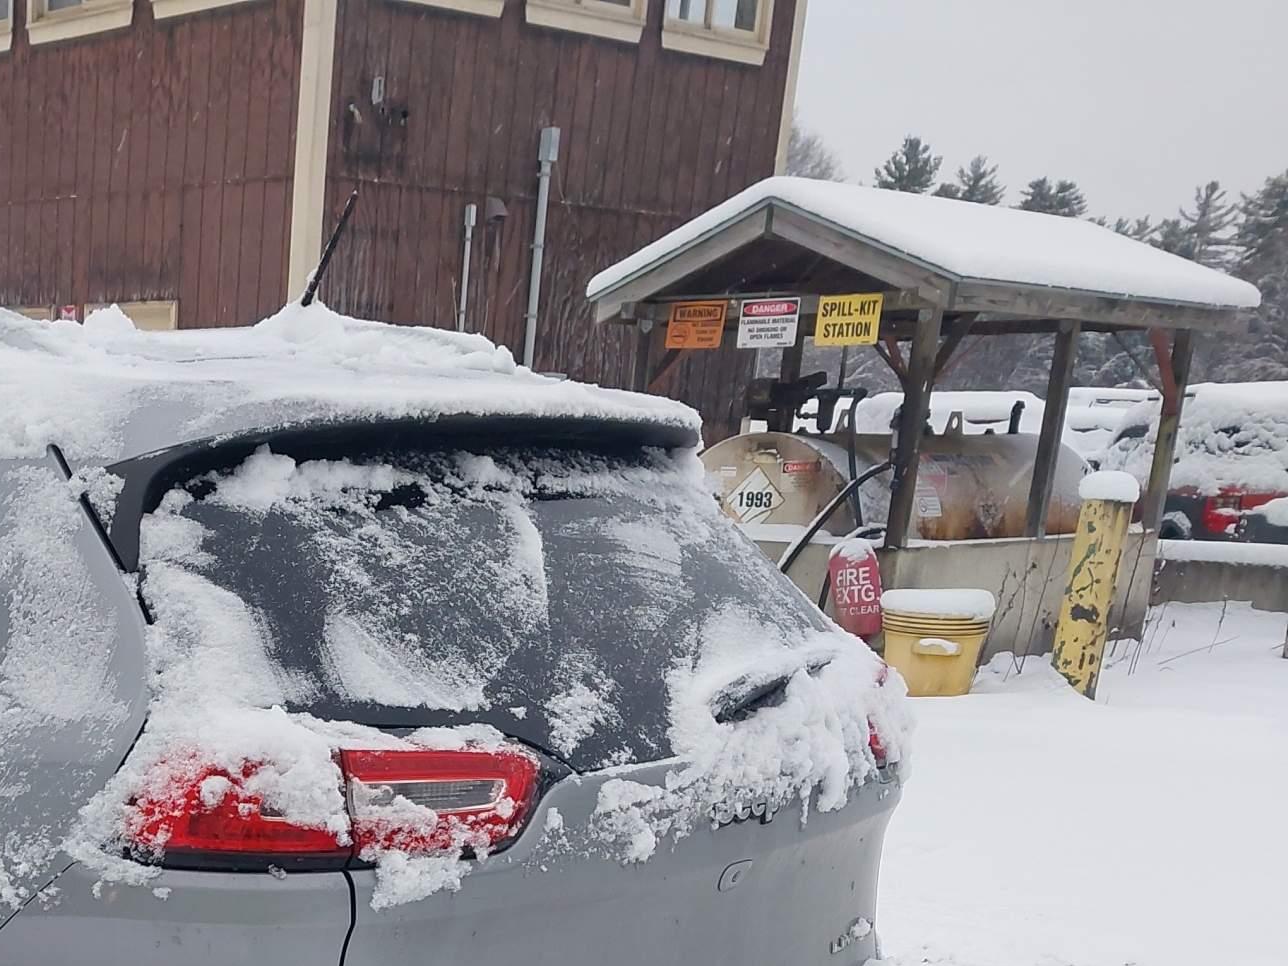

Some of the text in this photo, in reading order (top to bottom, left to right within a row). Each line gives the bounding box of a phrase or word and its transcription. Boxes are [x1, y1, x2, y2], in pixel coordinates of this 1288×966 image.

[679, 308, 719, 318] WARNING
[752, 303, 789, 313] DANGER
[822, 300, 879, 317] SPILL-KIT
[823, 322, 871, 338] STATION
[738, 491, 772, 508] 1993
[836, 566, 871, 587] FIRE
[836, 584, 880, 604] EXTG.
[849, 605, 880, 616] CLEAR
